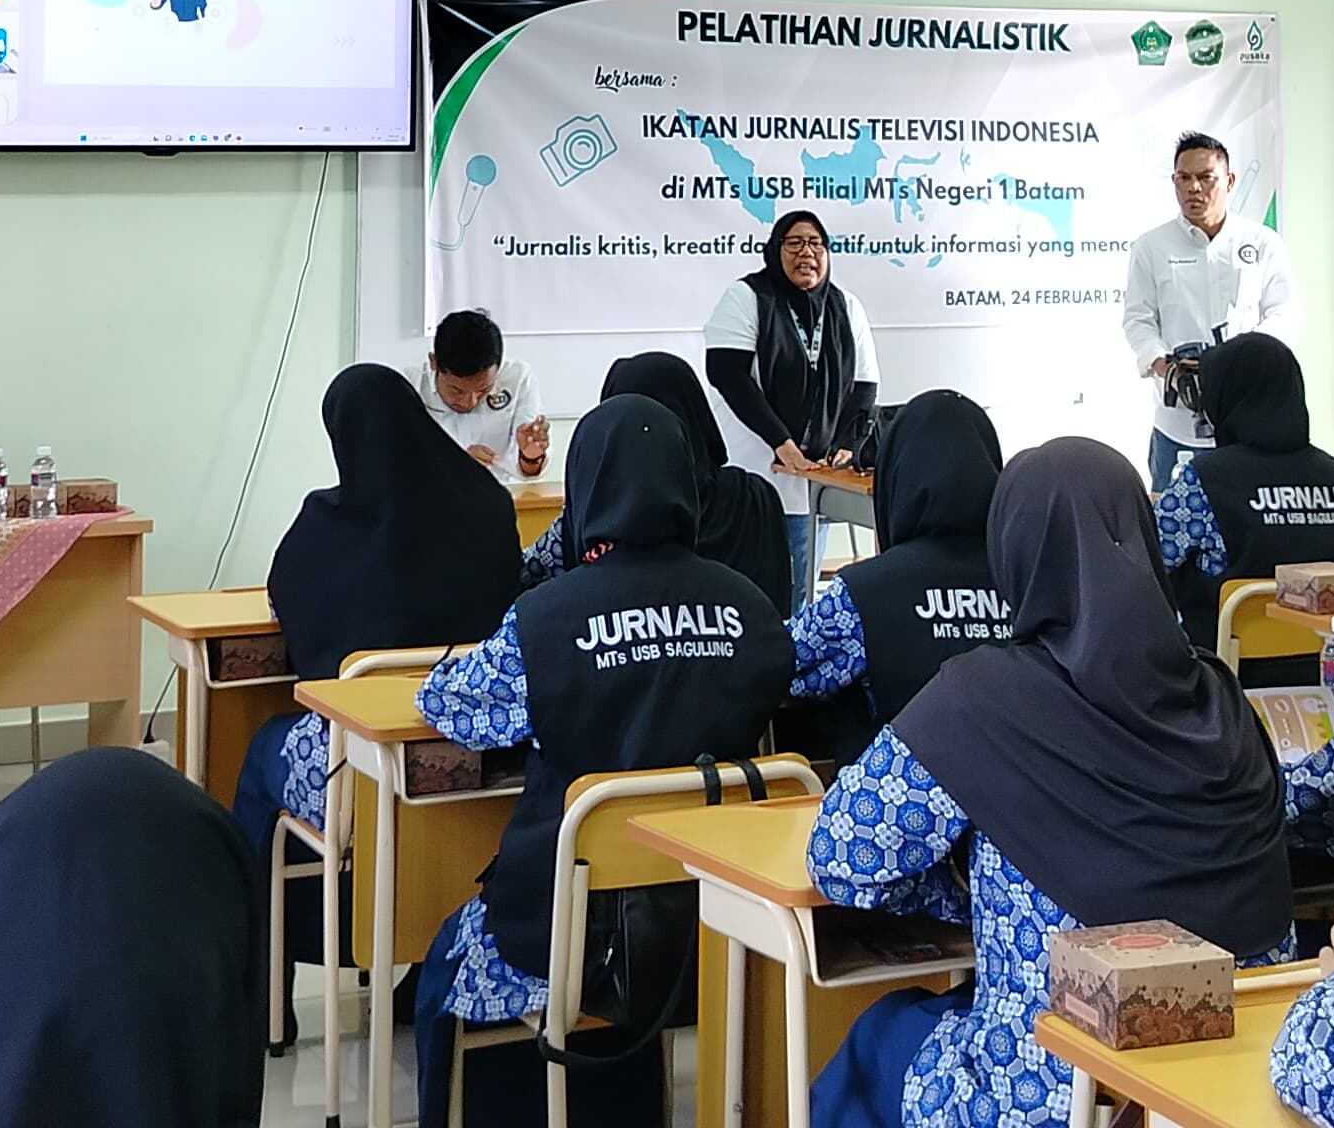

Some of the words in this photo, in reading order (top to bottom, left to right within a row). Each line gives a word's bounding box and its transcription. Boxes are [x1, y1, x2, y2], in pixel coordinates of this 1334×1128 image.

[677, 10, 861, 47] PELATIHAN
[868, 18, 1071, 52] JURNALISTIK
[594, 65, 666, 92] bersama
[642, 115, 737, 139] IKATAN
[744, 116, 861, 140] JURNALIS
[867, 118, 965, 142] TELEVISI
[971, 120, 1100, 144] INDONESIA
[661, 176, 684, 199] di
[692, 177, 740, 199] MTs
[748, 177, 795, 199] USB
[802, 176, 857, 199] Filial
[865, 178, 909, 200] MTs
[917, 177, 993, 206] Negeri
[999, 178, 1008, 200] 1
[1014, 179, 1085, 201] Batam
[597, 234, 658, 259] kritis,
[664, 234, 735, 255] kreatif
[740, 234, 767, 254] da
[830, 234, 865, 255] atif
[869, 234, 925, 254] untuk
[931, 235, 1021, 254] informasi
[1027, 239, 1074, 258] yang
[1081, 240, 1132, 252] menc
[945, 289, 1006, 307] BATAM,
[1011, 290, 1031, 305] 24
[1035, 289, 1108, 305] FEBRUARI
[1263, 512, 1285, 525] MTs
[576, 604, 744, 650] JURNALIS
[933, 622, 961, 639] MTs
[964, 623, 991, 639] USB
[596, 650, 627, 670] MTs
[631, 644, 661, 662] USB
[665, 641, 734, 657] SAGULUNG
